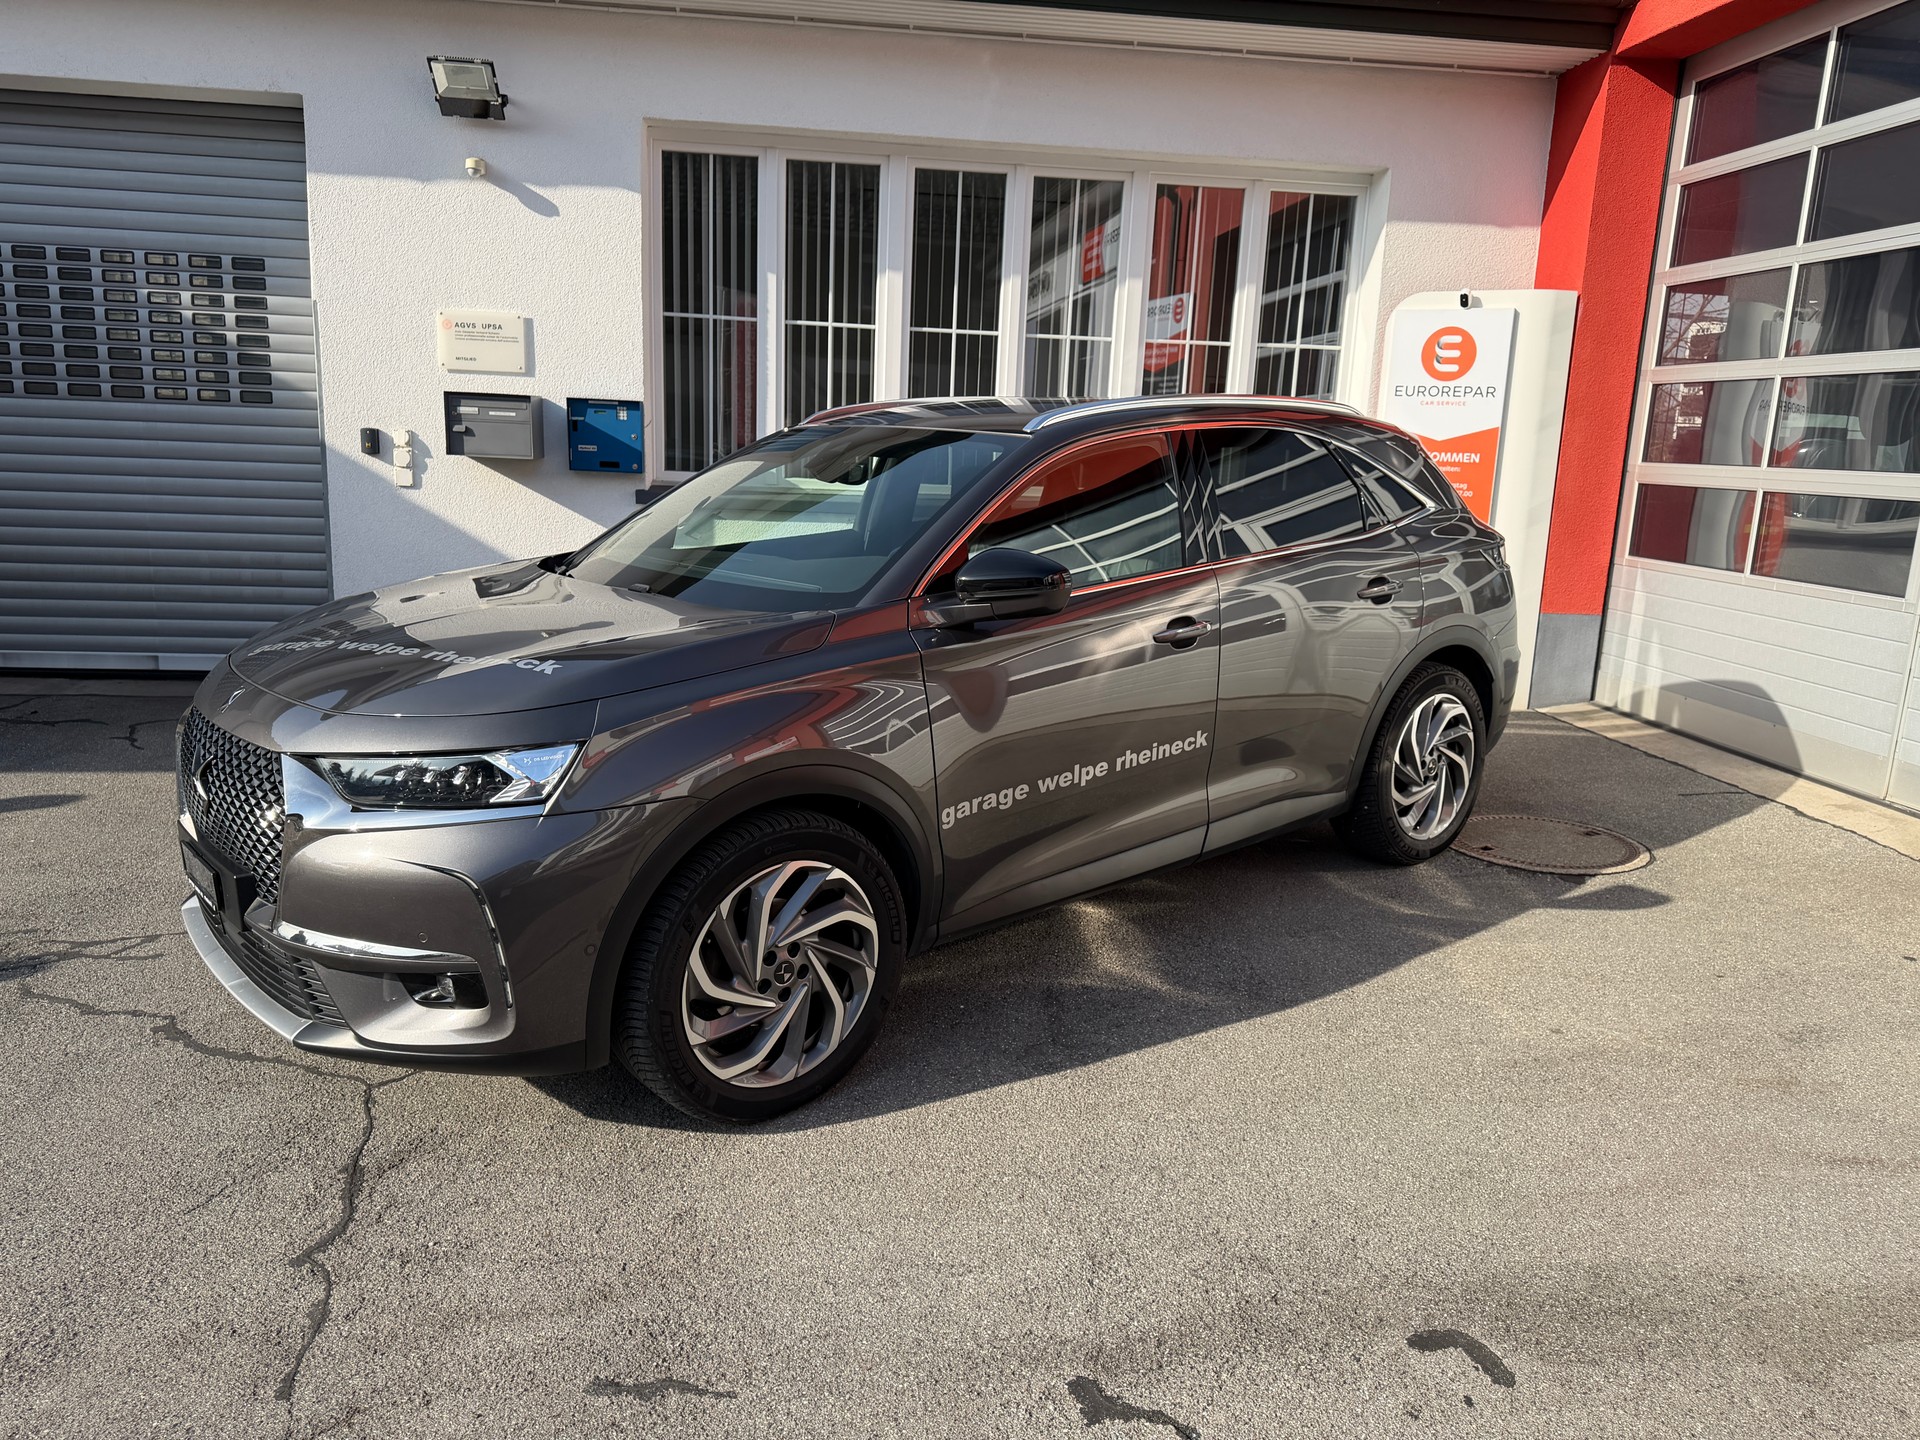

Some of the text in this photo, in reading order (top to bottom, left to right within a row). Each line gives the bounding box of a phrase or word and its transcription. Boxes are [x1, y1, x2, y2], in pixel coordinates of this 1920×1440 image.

[454, 321, 477, 329] AGVS
[1394, 385, 1497, 399] EUROREPAR
[247, 640, 336, 656] garage
[337, 641, 421, 656] welpe
[941, 730, 1209, 830] garage welpe rheineck
